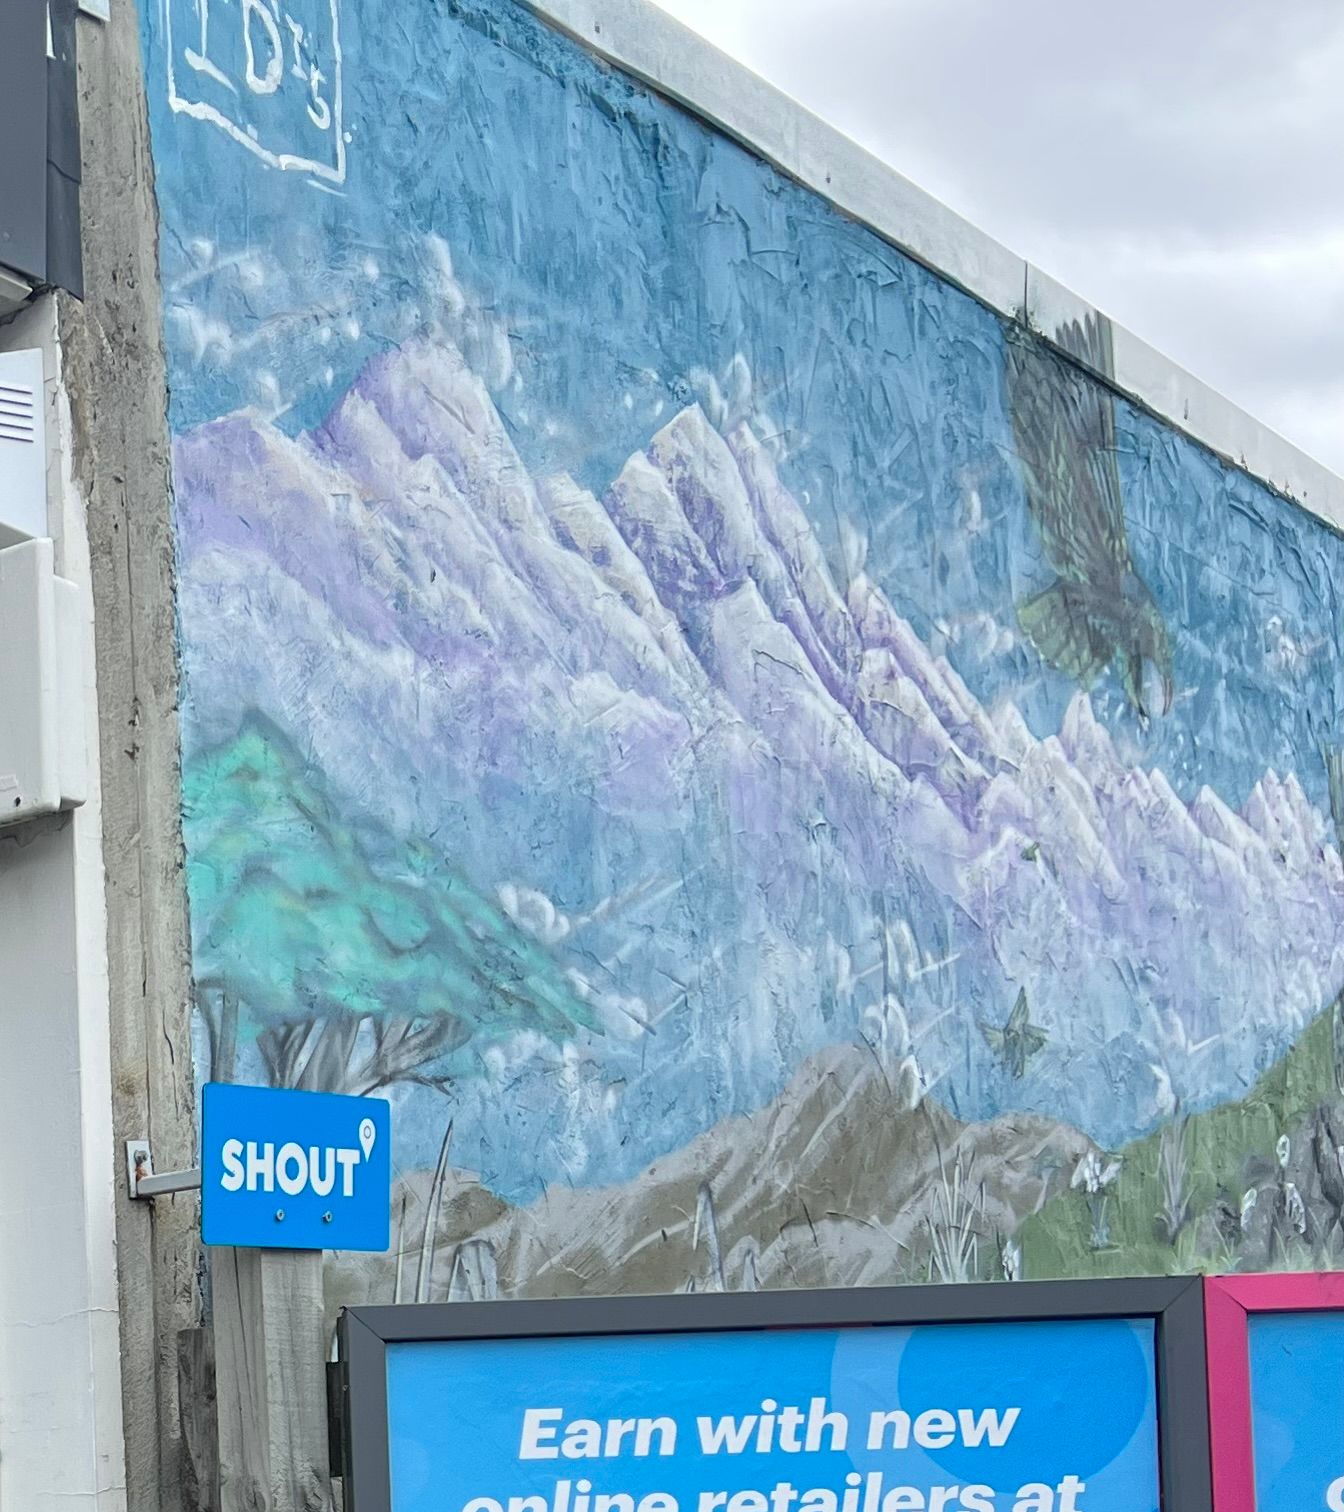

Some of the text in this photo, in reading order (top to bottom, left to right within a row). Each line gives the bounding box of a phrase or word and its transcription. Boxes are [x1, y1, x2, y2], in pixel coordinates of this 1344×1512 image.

[220, 1138, 360, 1197] SHOUT
[519, 1397, 1020, 1460] Earn with new
